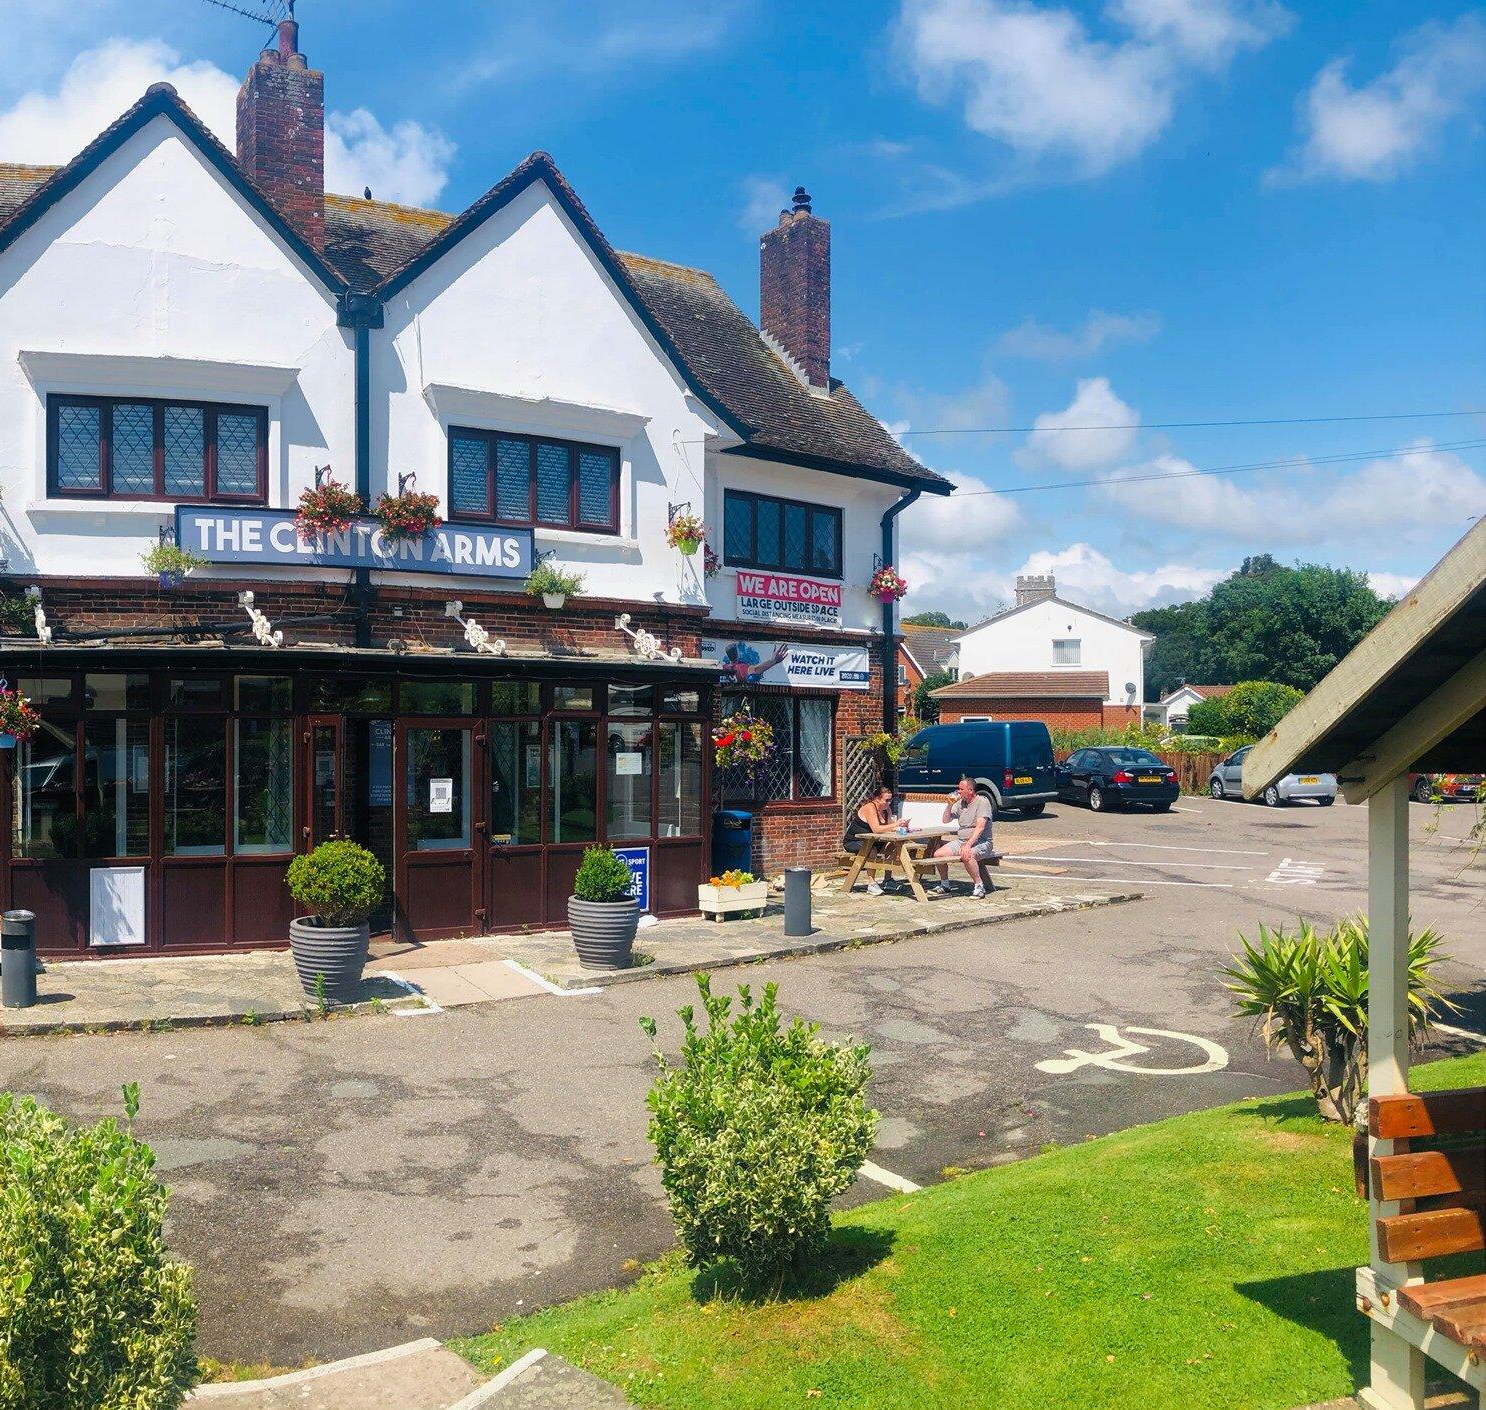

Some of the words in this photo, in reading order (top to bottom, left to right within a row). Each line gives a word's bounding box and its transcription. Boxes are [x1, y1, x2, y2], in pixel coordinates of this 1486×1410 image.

[194, 518, 263, 552] THE
[269, 521, 423, 562] CLINTON
[430, 532, 521, 568] ARMS
[739, 574, 765, 595] WE
[767, 579, 798, 598] ARE
[799, 582, 839, 603] OPEN
[741, 597, 772, 609] LARGE
[774, 600, 810, 613] OUTSIDE
[811, 605, 839, 617] SPACE
[791, 654, 823, 665] WATCH
[826, 657, 835, 666] IT
[787, 665, 813, 675] HERE
[814, 667, 835, 676] LIVE
